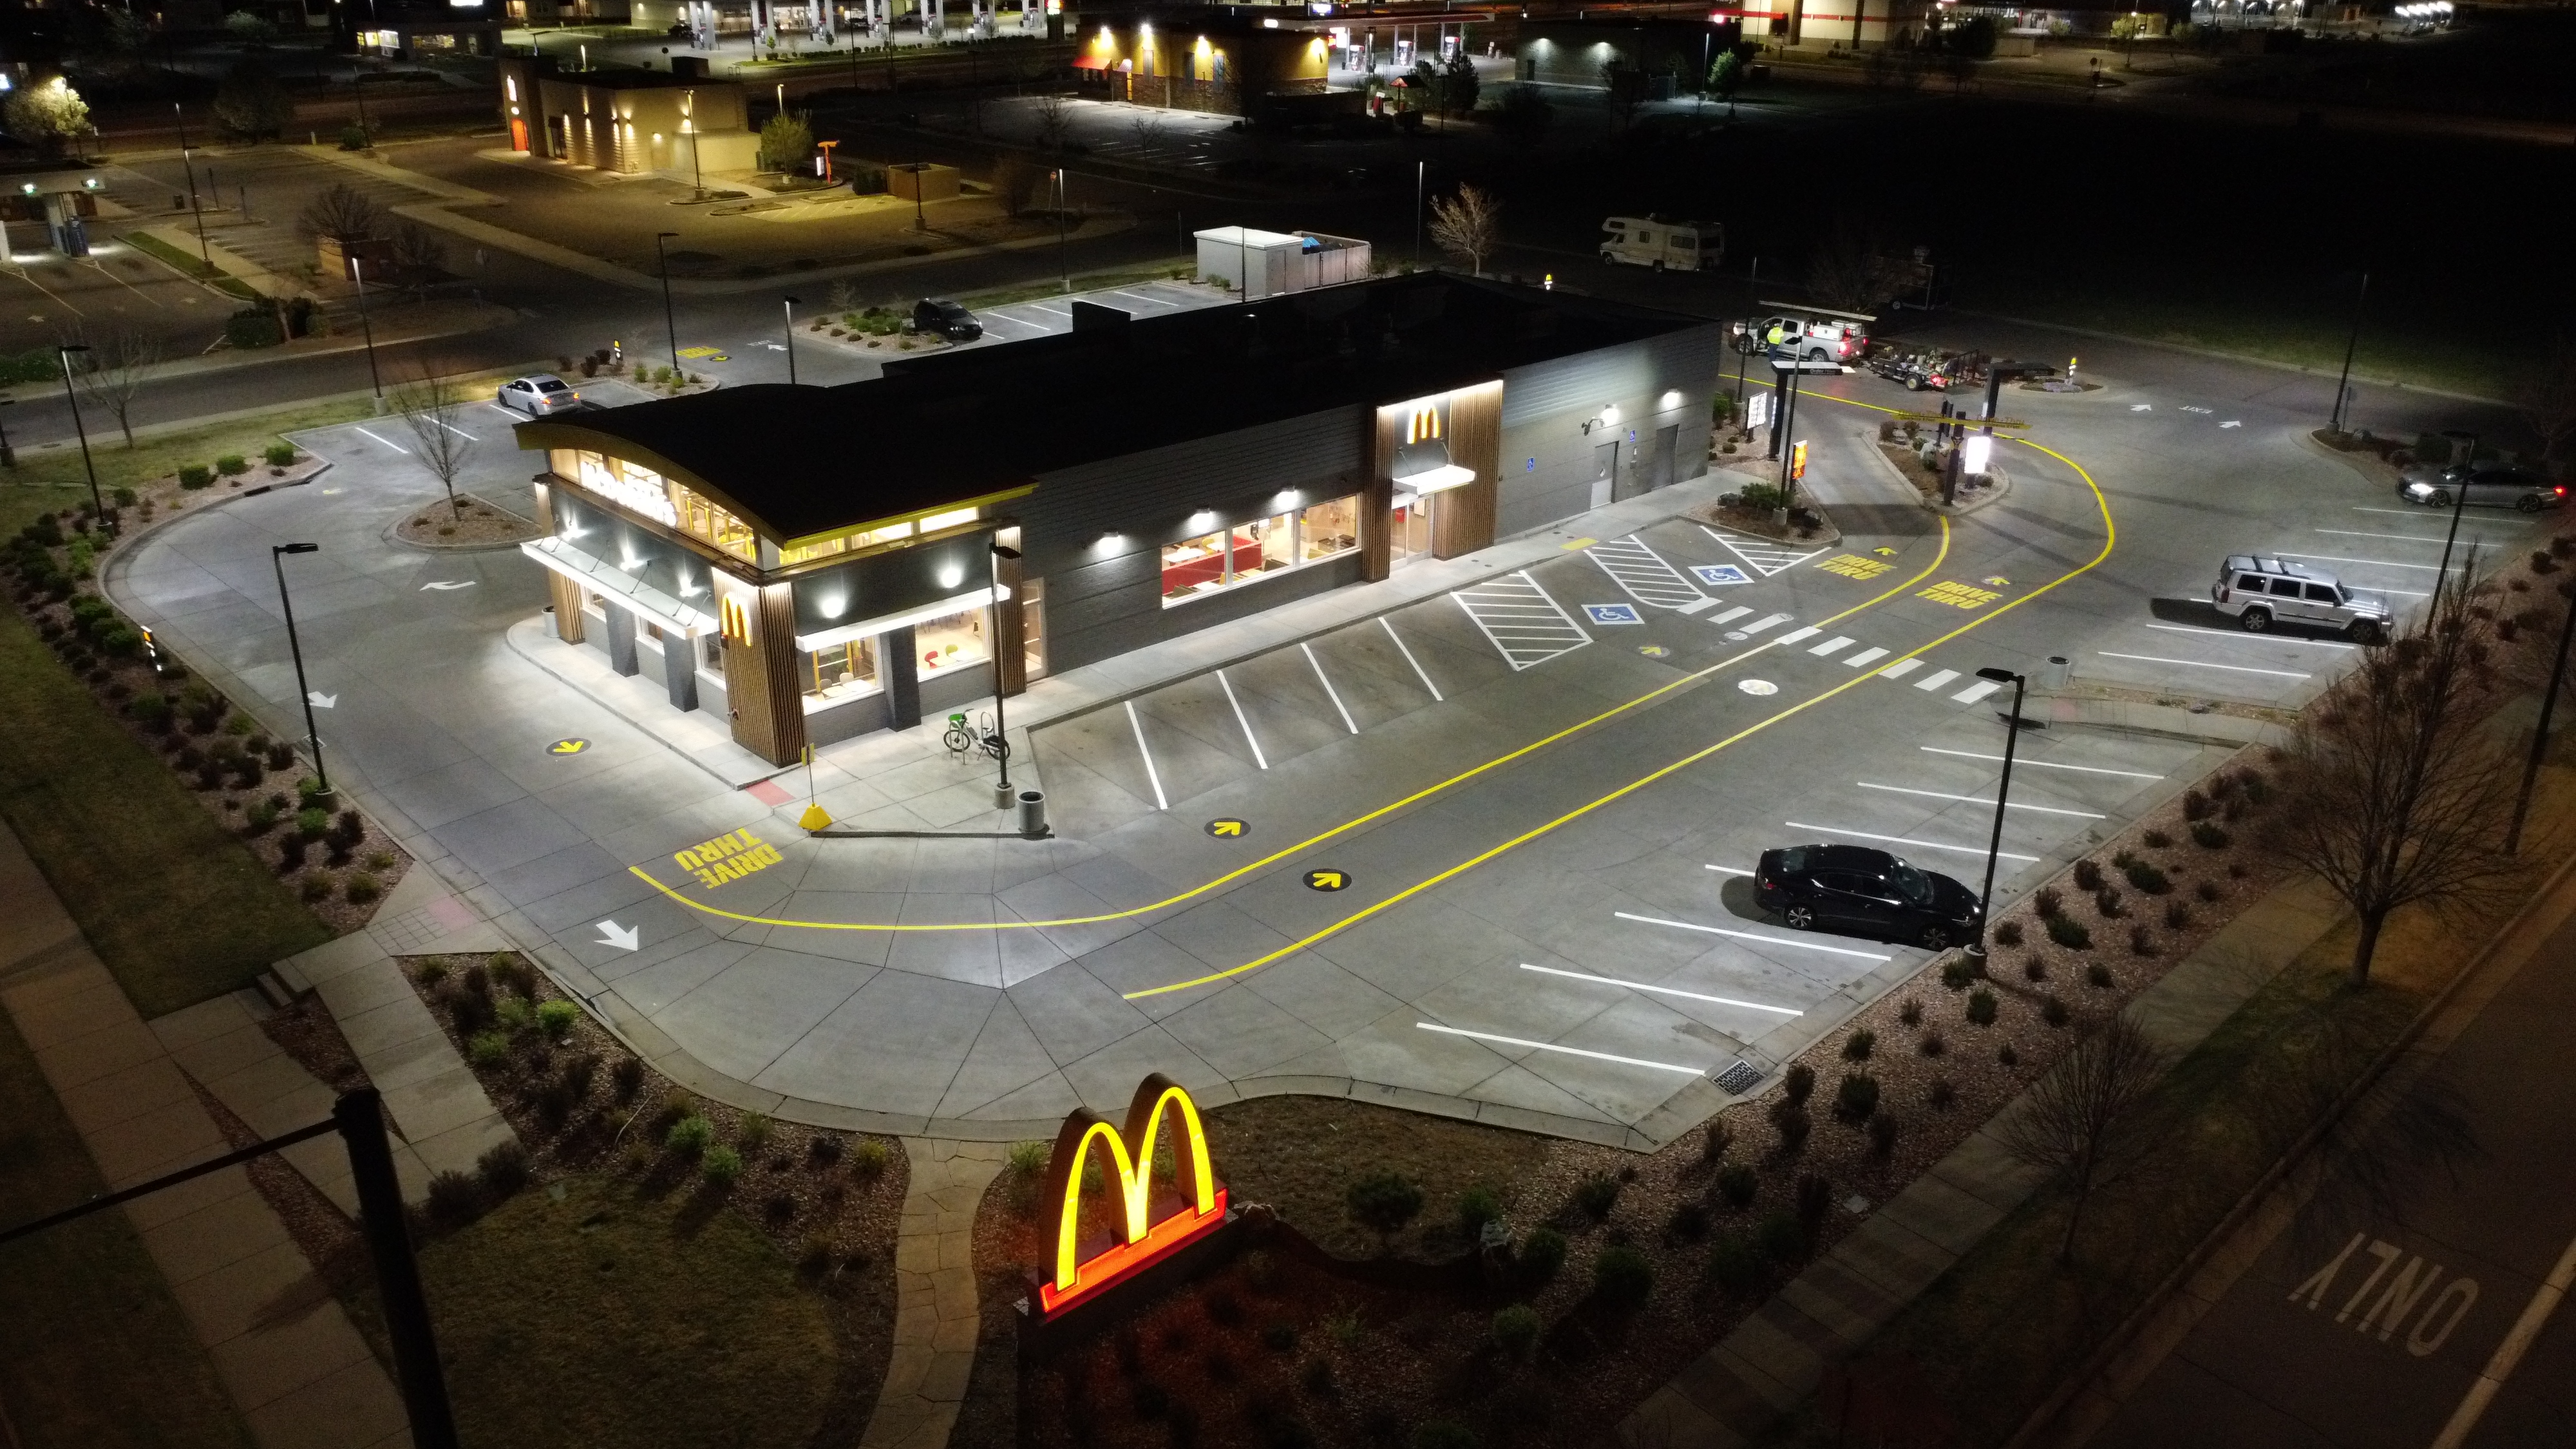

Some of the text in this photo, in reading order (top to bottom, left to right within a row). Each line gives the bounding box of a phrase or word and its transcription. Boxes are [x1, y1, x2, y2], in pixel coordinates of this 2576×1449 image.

[1813, 560, 1879, 580] THRU
[1830, 554, 1897, 573] DRIVE
[1914, 588, 1985, 609] THRU
[1931, 581, 2003, 602] DRIVE
[674, 827, 762, 871] THRU
[693, 843, 784, 889] DRIVE
[2287, 1232, 2479, 1357] ONLY
